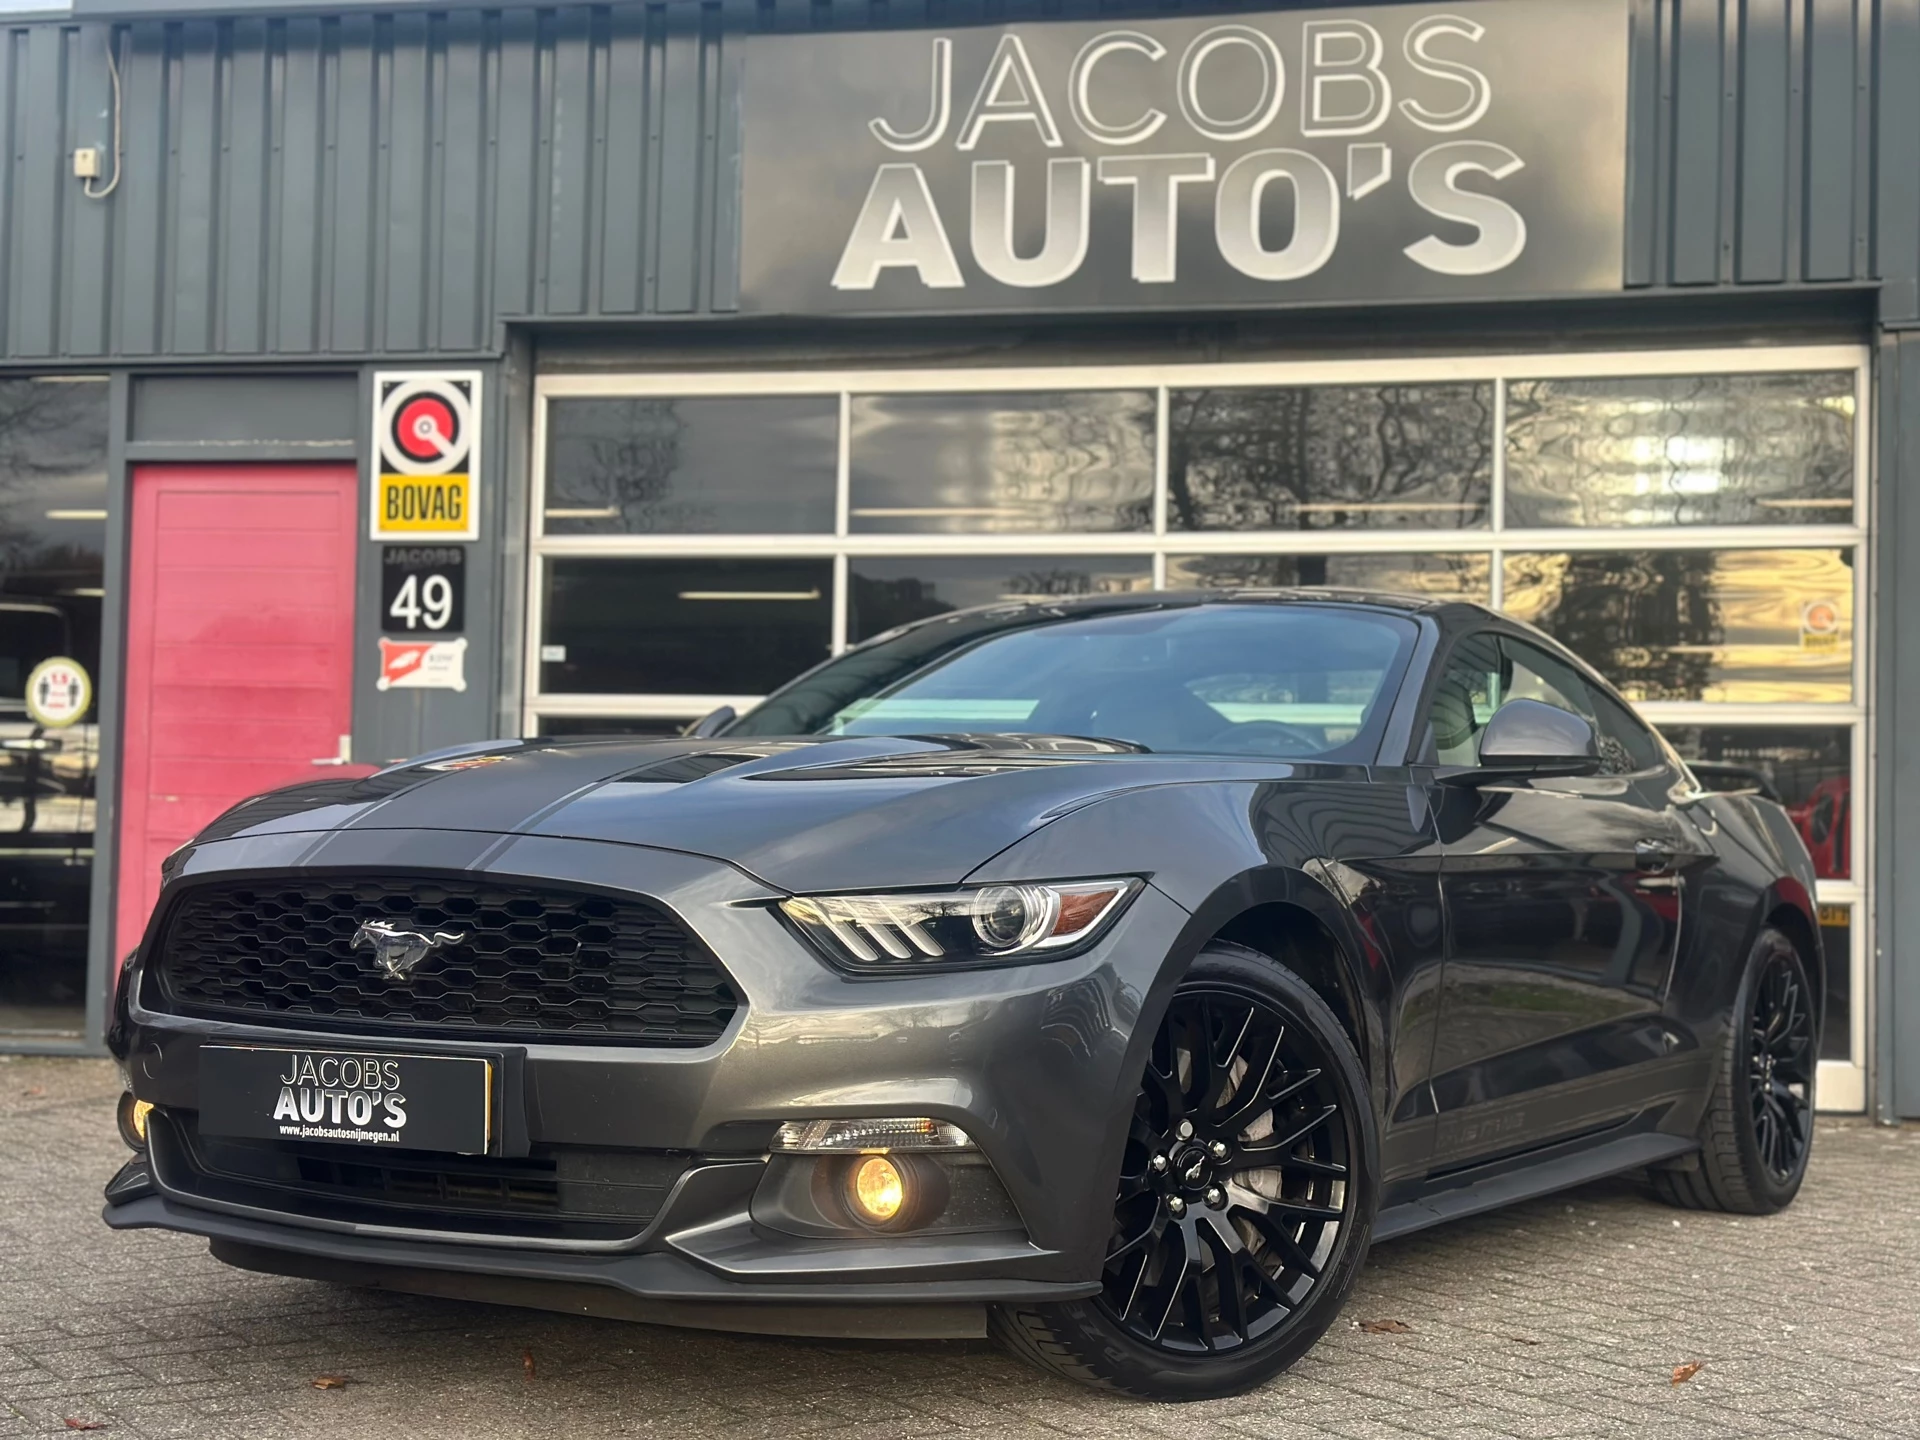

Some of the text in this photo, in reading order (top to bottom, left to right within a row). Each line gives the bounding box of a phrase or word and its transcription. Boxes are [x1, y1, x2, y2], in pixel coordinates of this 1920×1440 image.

[868, 14, 1491, 151] JACOBS
[831, 139, 1526, 288] AUTO'S
[386, 484, 462, 521] BOVAG
[389, 574, 453, 630] 49
[279, 1054, 400, 1090] JACOBS
[273, 1086, 407, 1128] AUTO'S
[279, 1124, 400, 1143] www.jacobsautosnijmegen.nl
